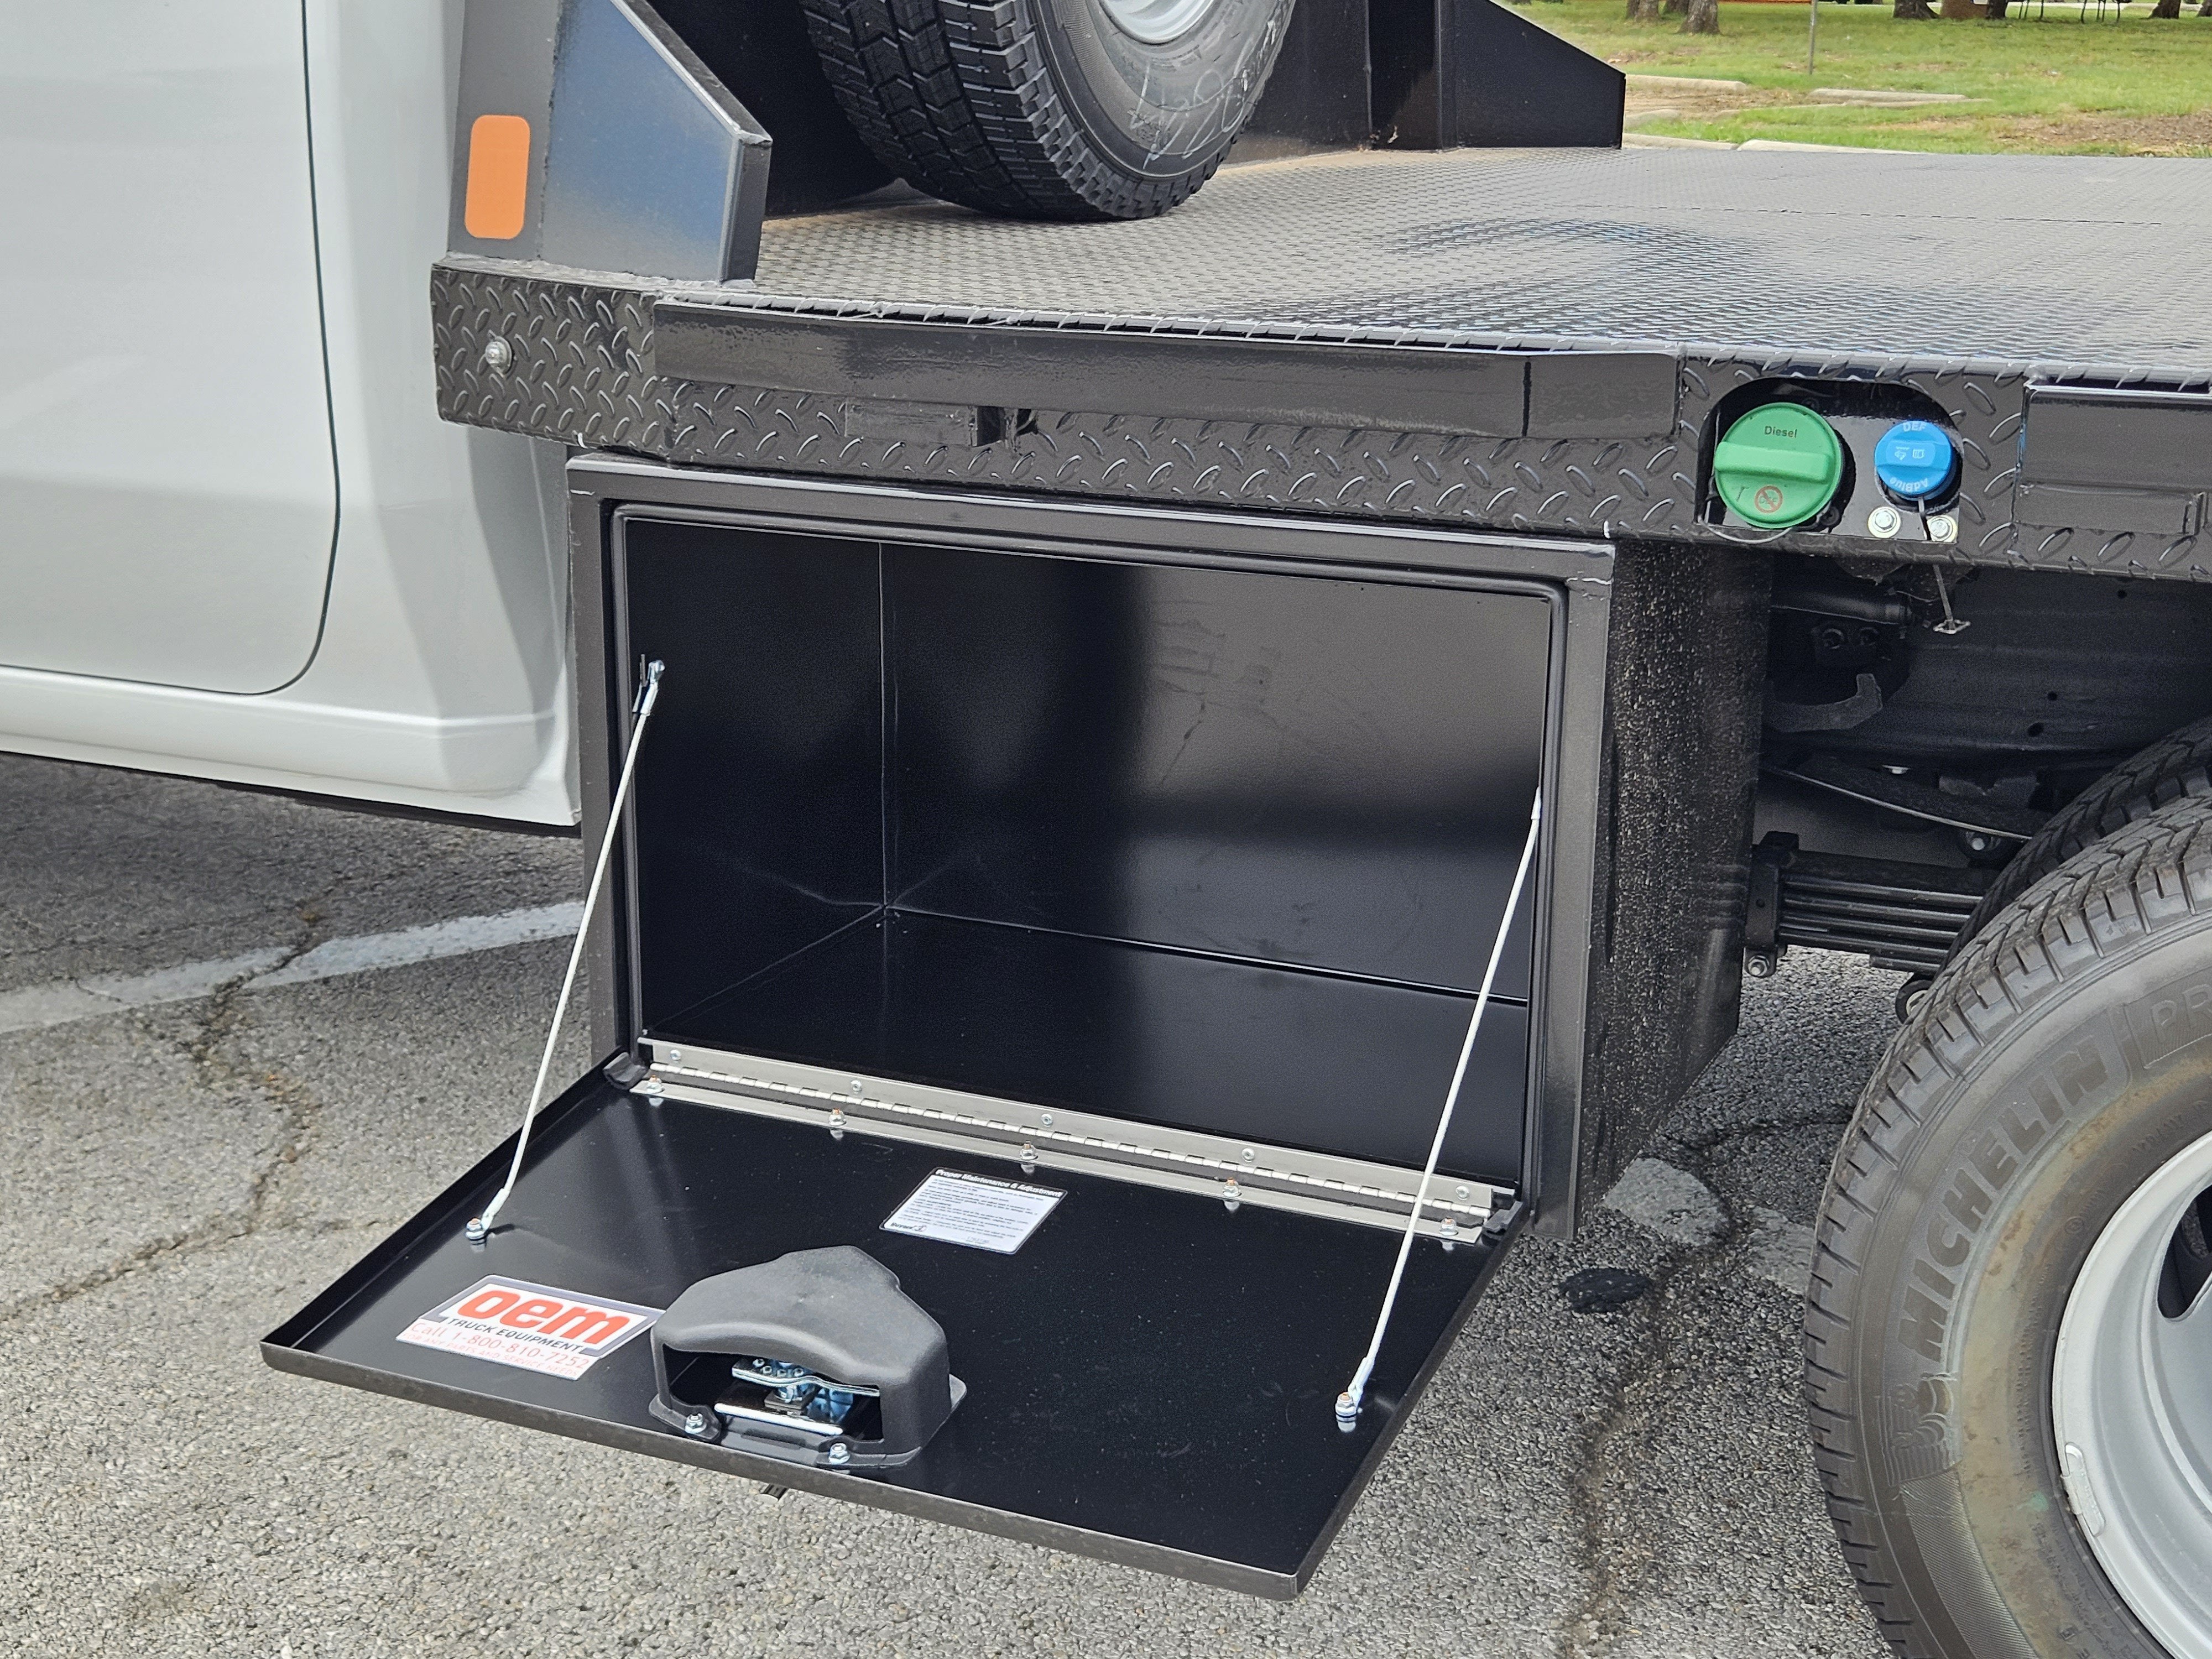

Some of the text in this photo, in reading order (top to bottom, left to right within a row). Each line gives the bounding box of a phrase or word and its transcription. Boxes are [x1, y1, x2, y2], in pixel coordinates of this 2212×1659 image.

[1764, 425, 1798, 439] Diesel
[1903, 421, 1927, 432] DEF
[1890, 477, 1929, 493] AdBlue
[935, 1168, 963, 1178] Proper
[1898, 1034, 2111, 1364] MICHELIN
[457, 1290, 631, 1343] oem
[411, 1322, 590, 1369] Call 1-800-810-7252
[447, 1318, 583, 1352] TRUCK EQUIPMENT
